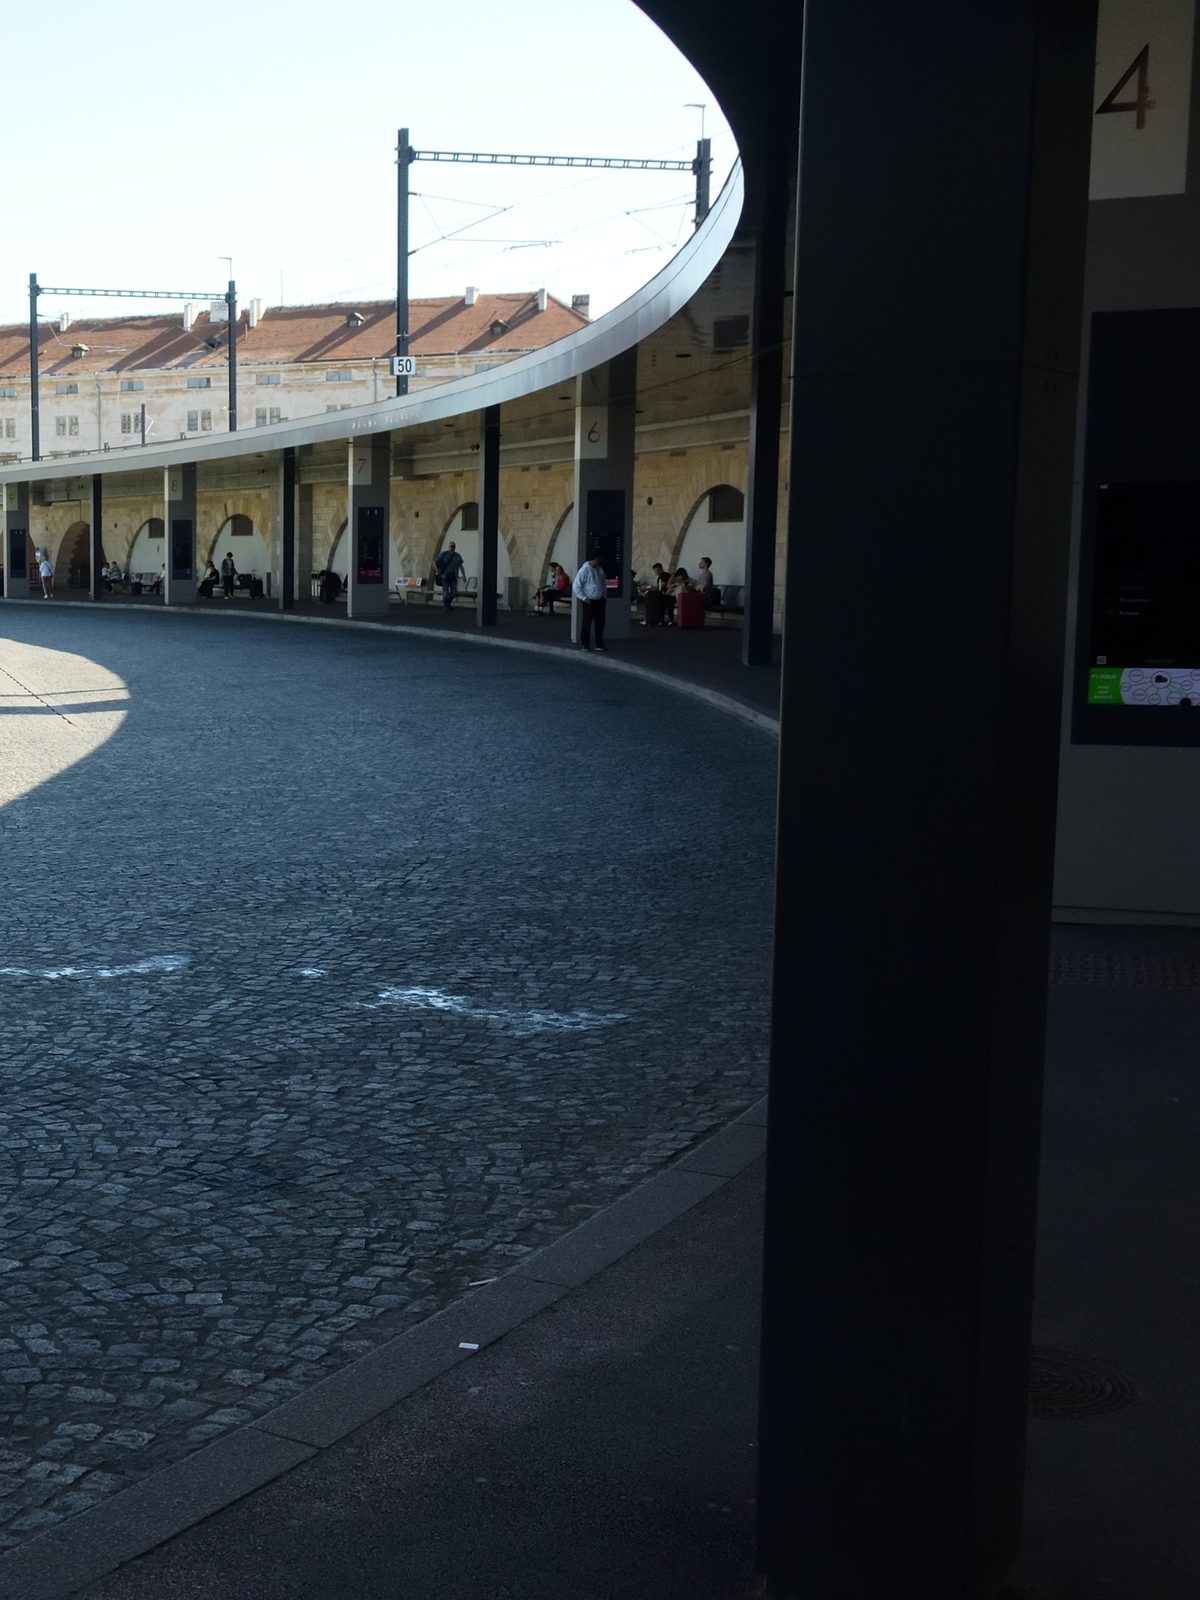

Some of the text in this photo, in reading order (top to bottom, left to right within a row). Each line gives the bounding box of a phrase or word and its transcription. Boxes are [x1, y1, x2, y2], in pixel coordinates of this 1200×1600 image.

[1095, 43, 1156, 130] 4
[398, 358, 412, 373] 50
[587, 421, 600, 443] 6
[358, 458, 367, 474] 7
